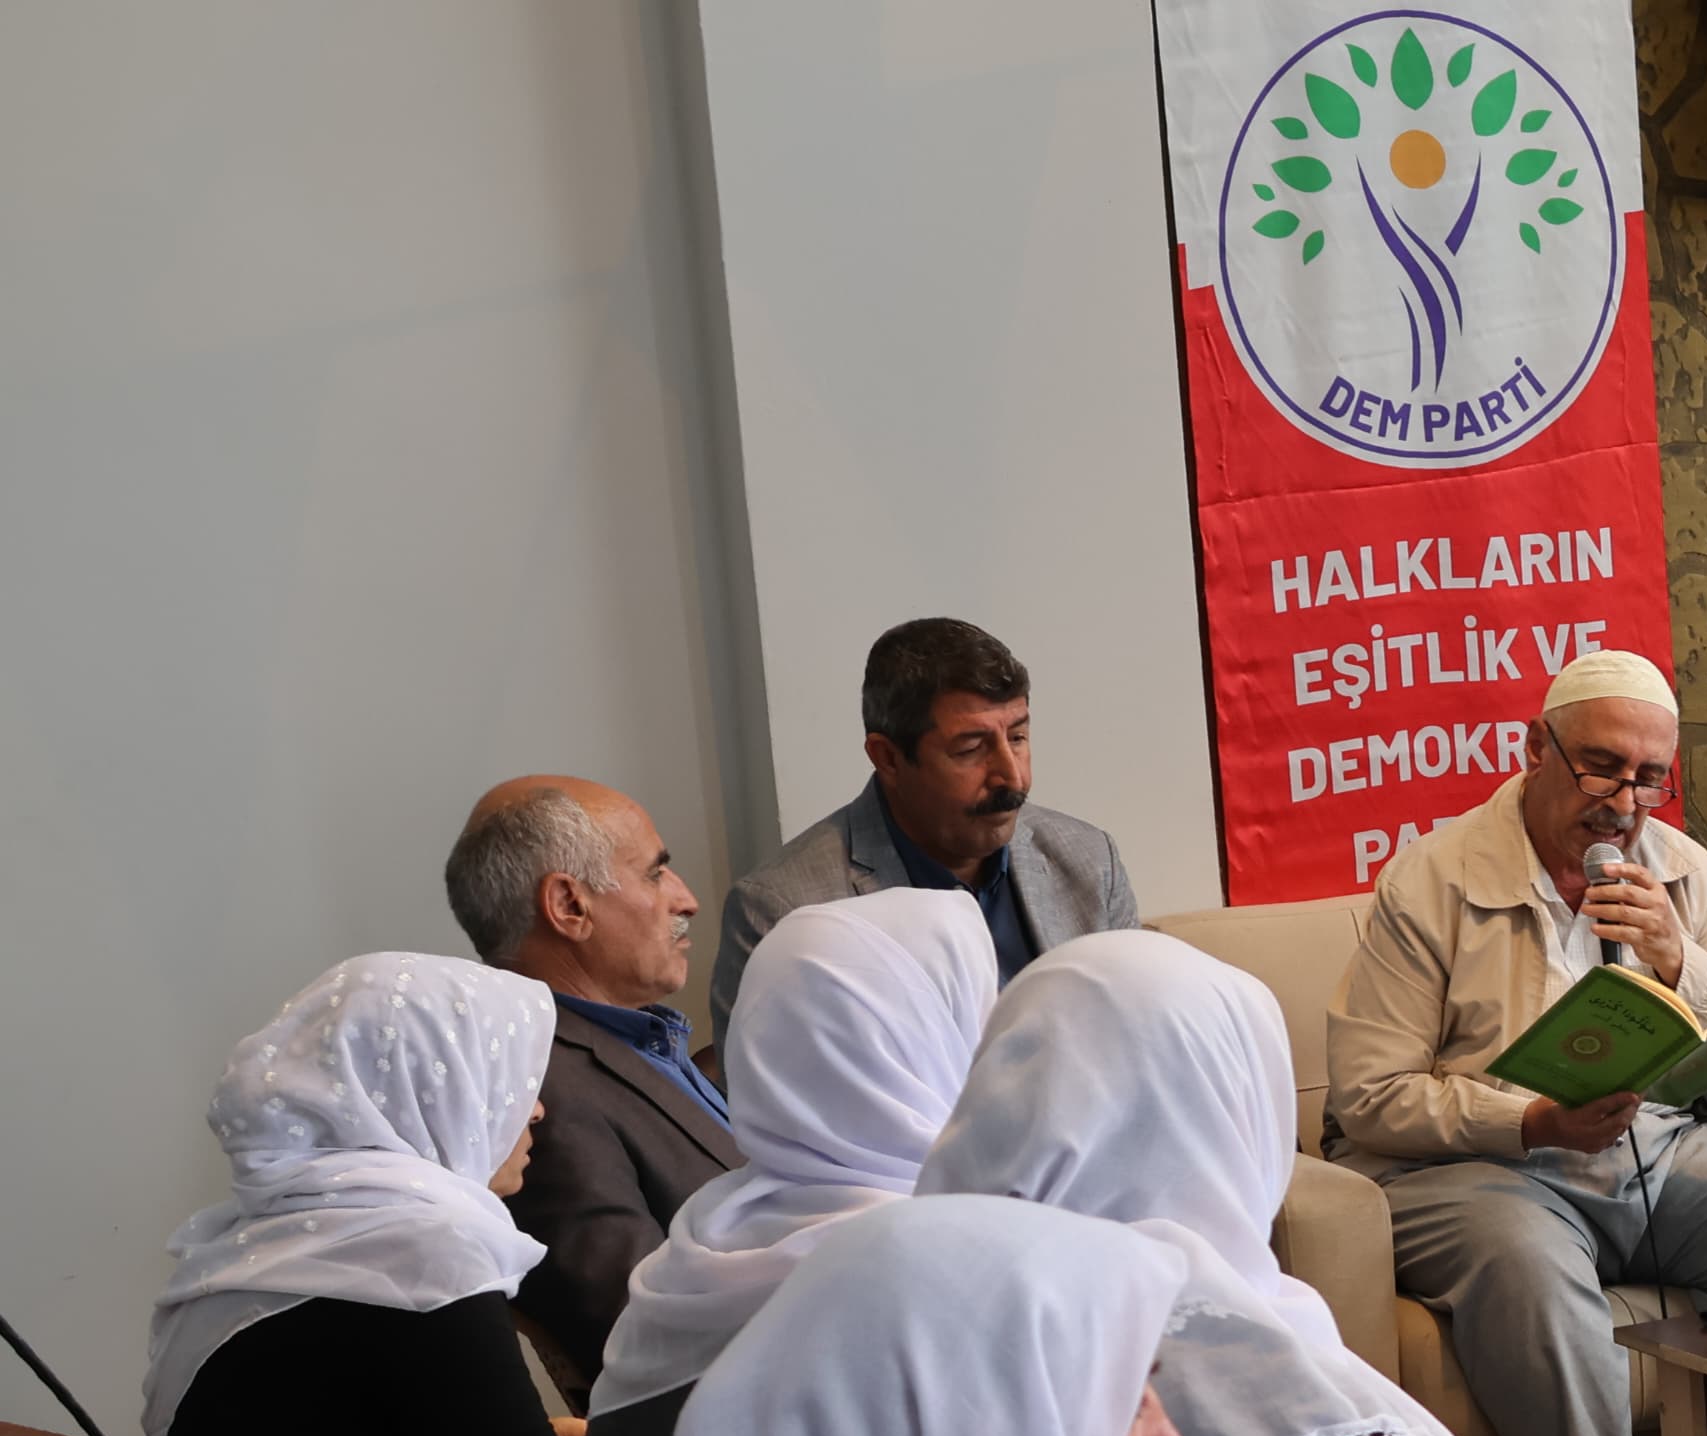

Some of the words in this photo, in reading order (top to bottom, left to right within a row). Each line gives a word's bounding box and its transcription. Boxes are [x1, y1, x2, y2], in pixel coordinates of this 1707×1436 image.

[1319, 374, 1411, 441] DEM
[1423, 355, 1547, 443] PARTİ
[1270, 527, 1614, 613] HALKLARIN
[1293, 615, 1522, 710] EŞİTLİK
[1287, 721, 1527, 803] DEMOKR
